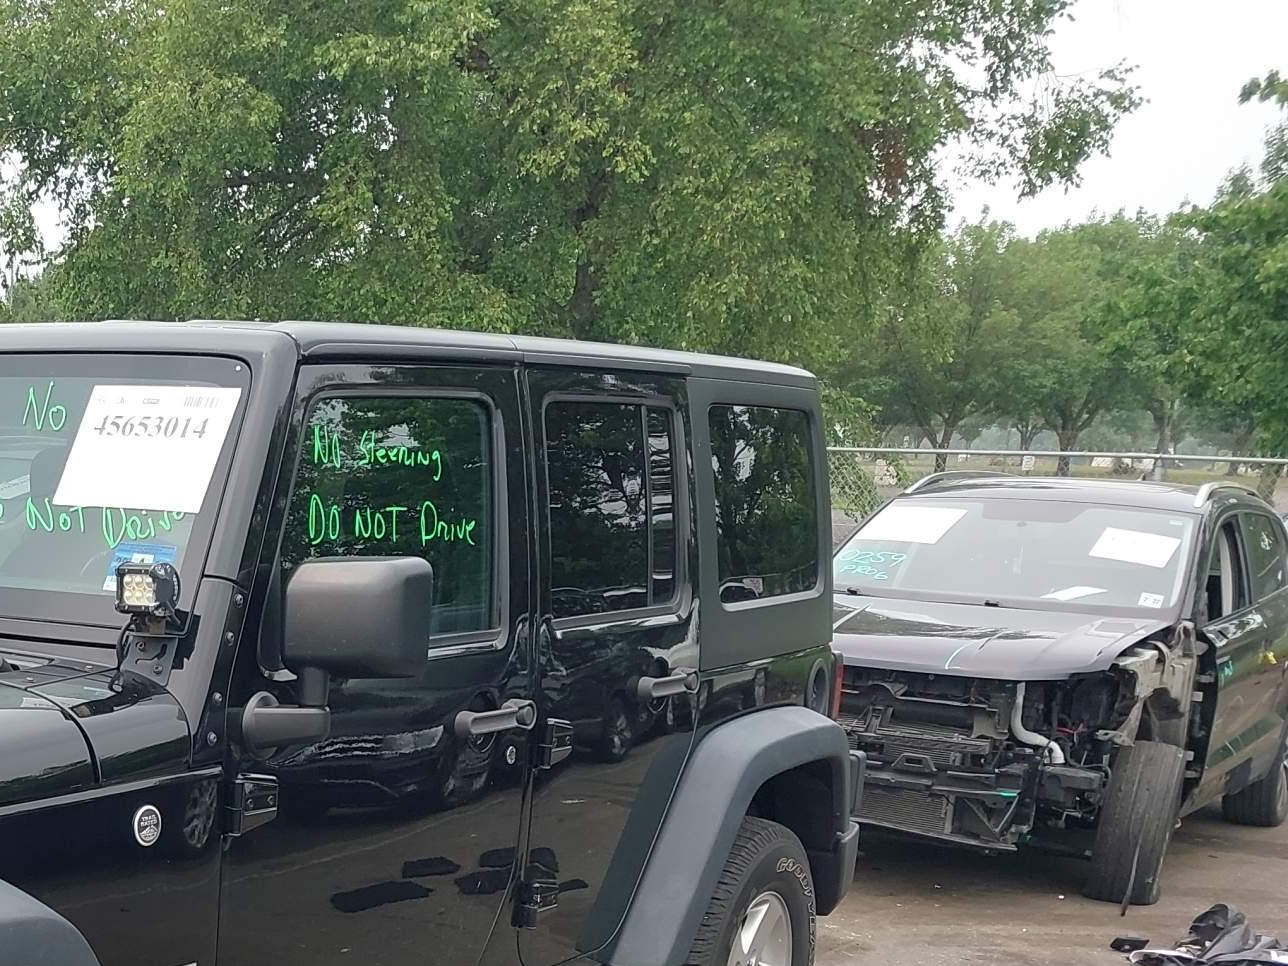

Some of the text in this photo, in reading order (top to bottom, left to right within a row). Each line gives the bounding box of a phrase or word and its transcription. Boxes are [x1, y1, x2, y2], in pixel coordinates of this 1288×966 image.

[23, 381, 66, 431] No
[94, 415, 209, 439] 45653014
[355, 506, 408, 542] NOT
[421, 501, 475, 547] Drive
